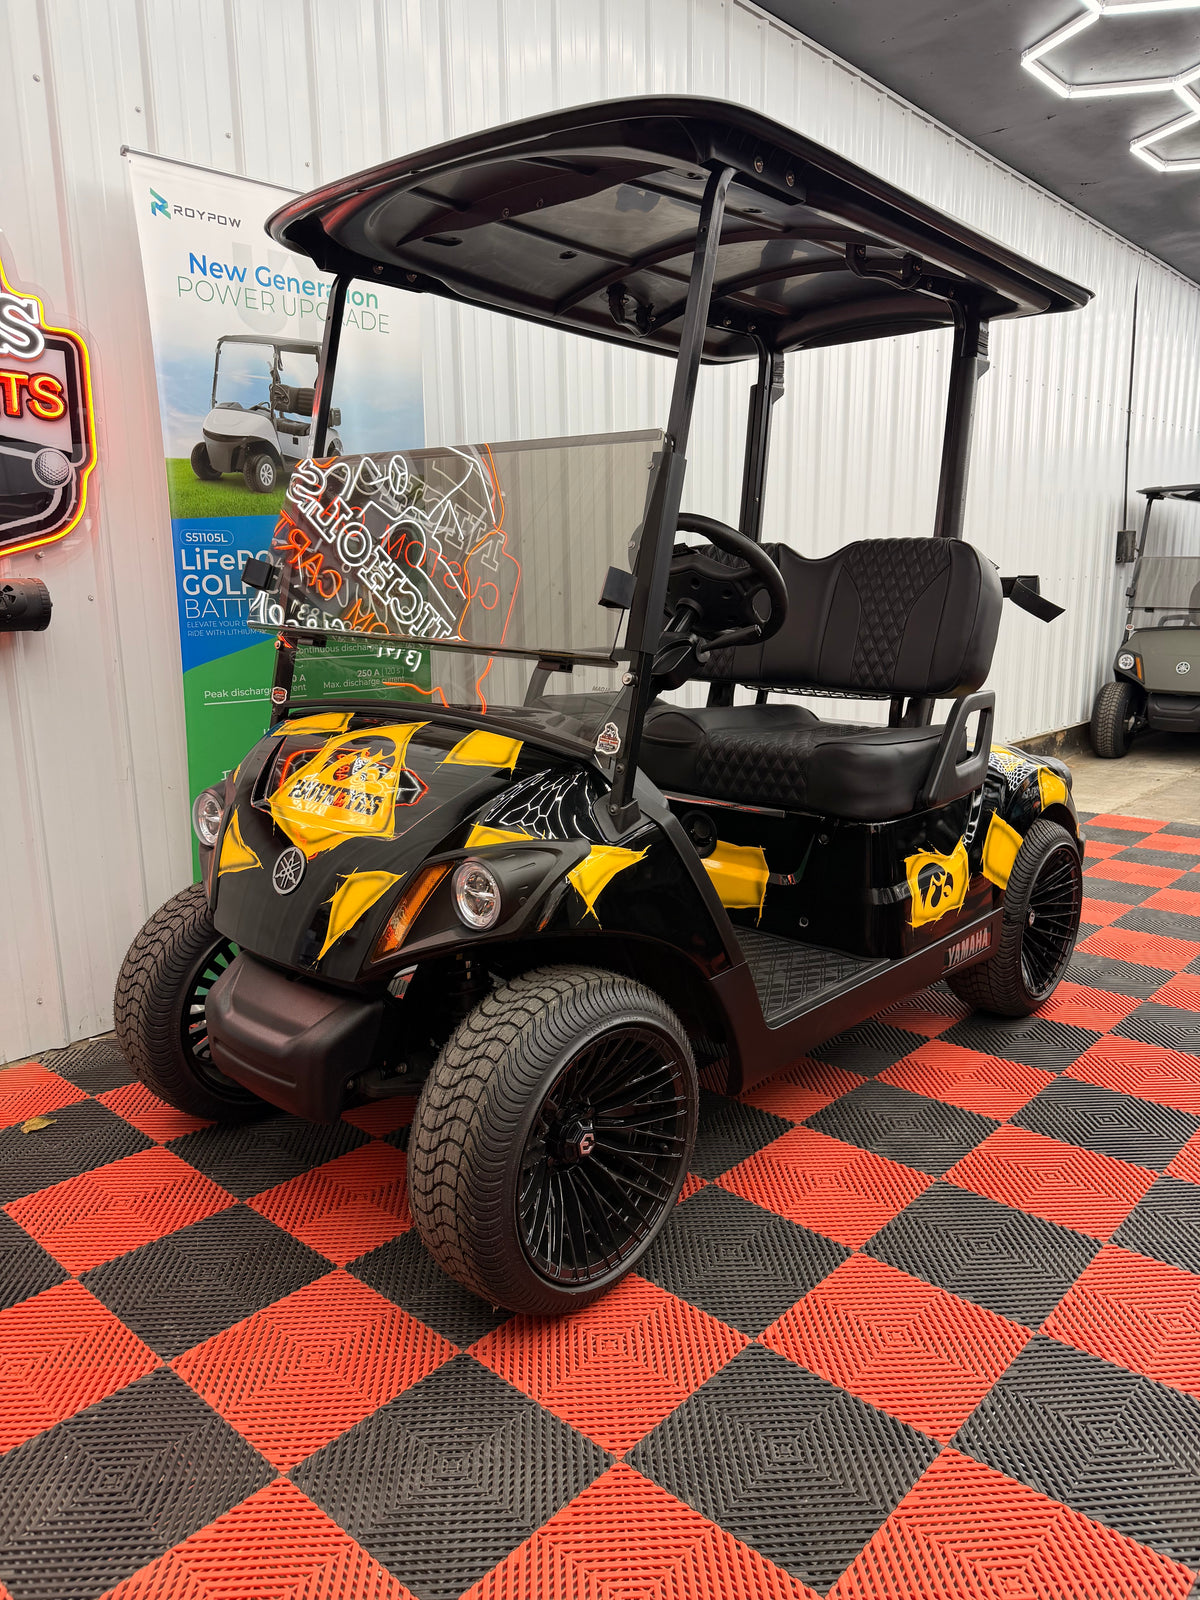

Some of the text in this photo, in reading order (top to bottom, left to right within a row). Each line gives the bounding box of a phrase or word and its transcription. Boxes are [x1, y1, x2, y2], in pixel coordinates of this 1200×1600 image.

[173, 205, 241, 228] ROYPOW
[188, 252, 379, 309] New Generion
[177, 275, 390, 334] POWER UPGADE
[185, 532, 228, 543] S51105L
[187, 620, 217, 628] ELEVATE
[357, 669, 372, 678] 250
[373, 668, 380, 676] A
[323, 681, 341, 689] Max.
[343, 678, 380, 687] discharge
[204, 689, 229, 698] Peak
[230, 687, 272, 697] discharg
[948, 927, 989, 967] YAMAHA
